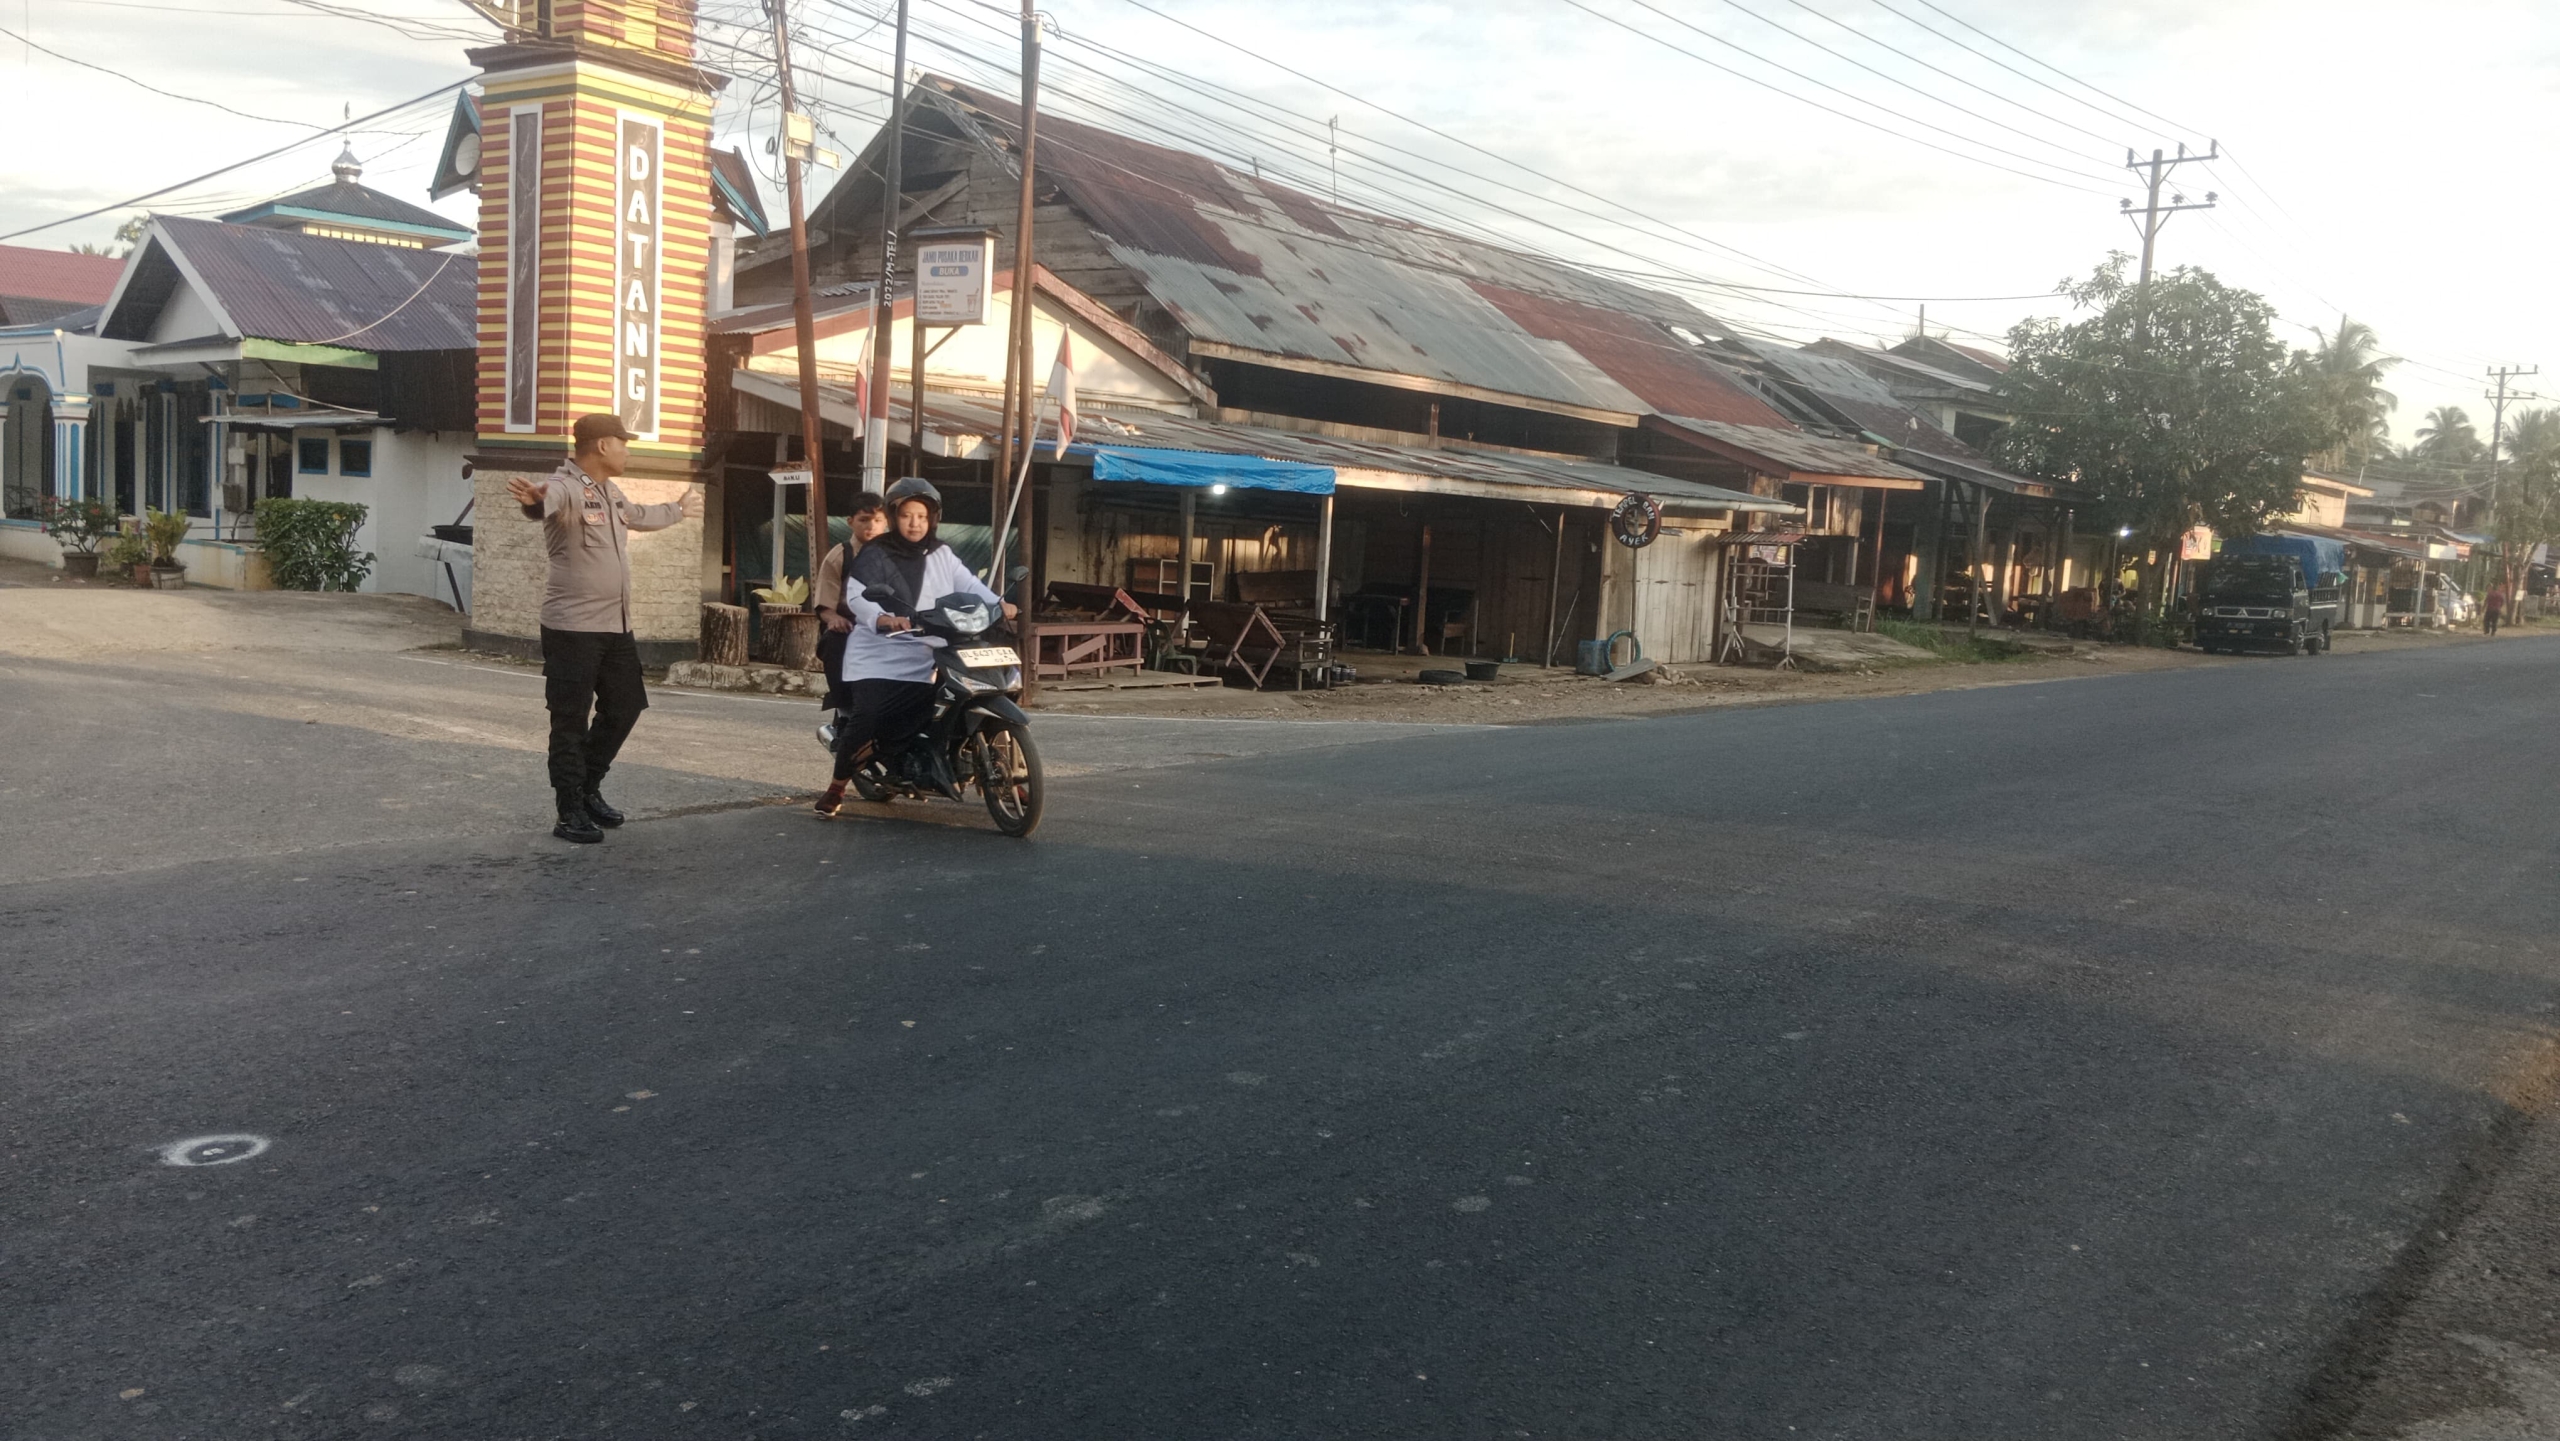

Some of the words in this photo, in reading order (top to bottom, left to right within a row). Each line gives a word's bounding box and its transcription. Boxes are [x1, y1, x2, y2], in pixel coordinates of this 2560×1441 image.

[626, 144, 651, 402] DATANG
[939, 267, 960, 276] BUKA
[1612, 496, 1638, 518] TEMPEL
[1642, 501, 1655, 520] BAN
[1619, 533, 1649, 545] AYEK
